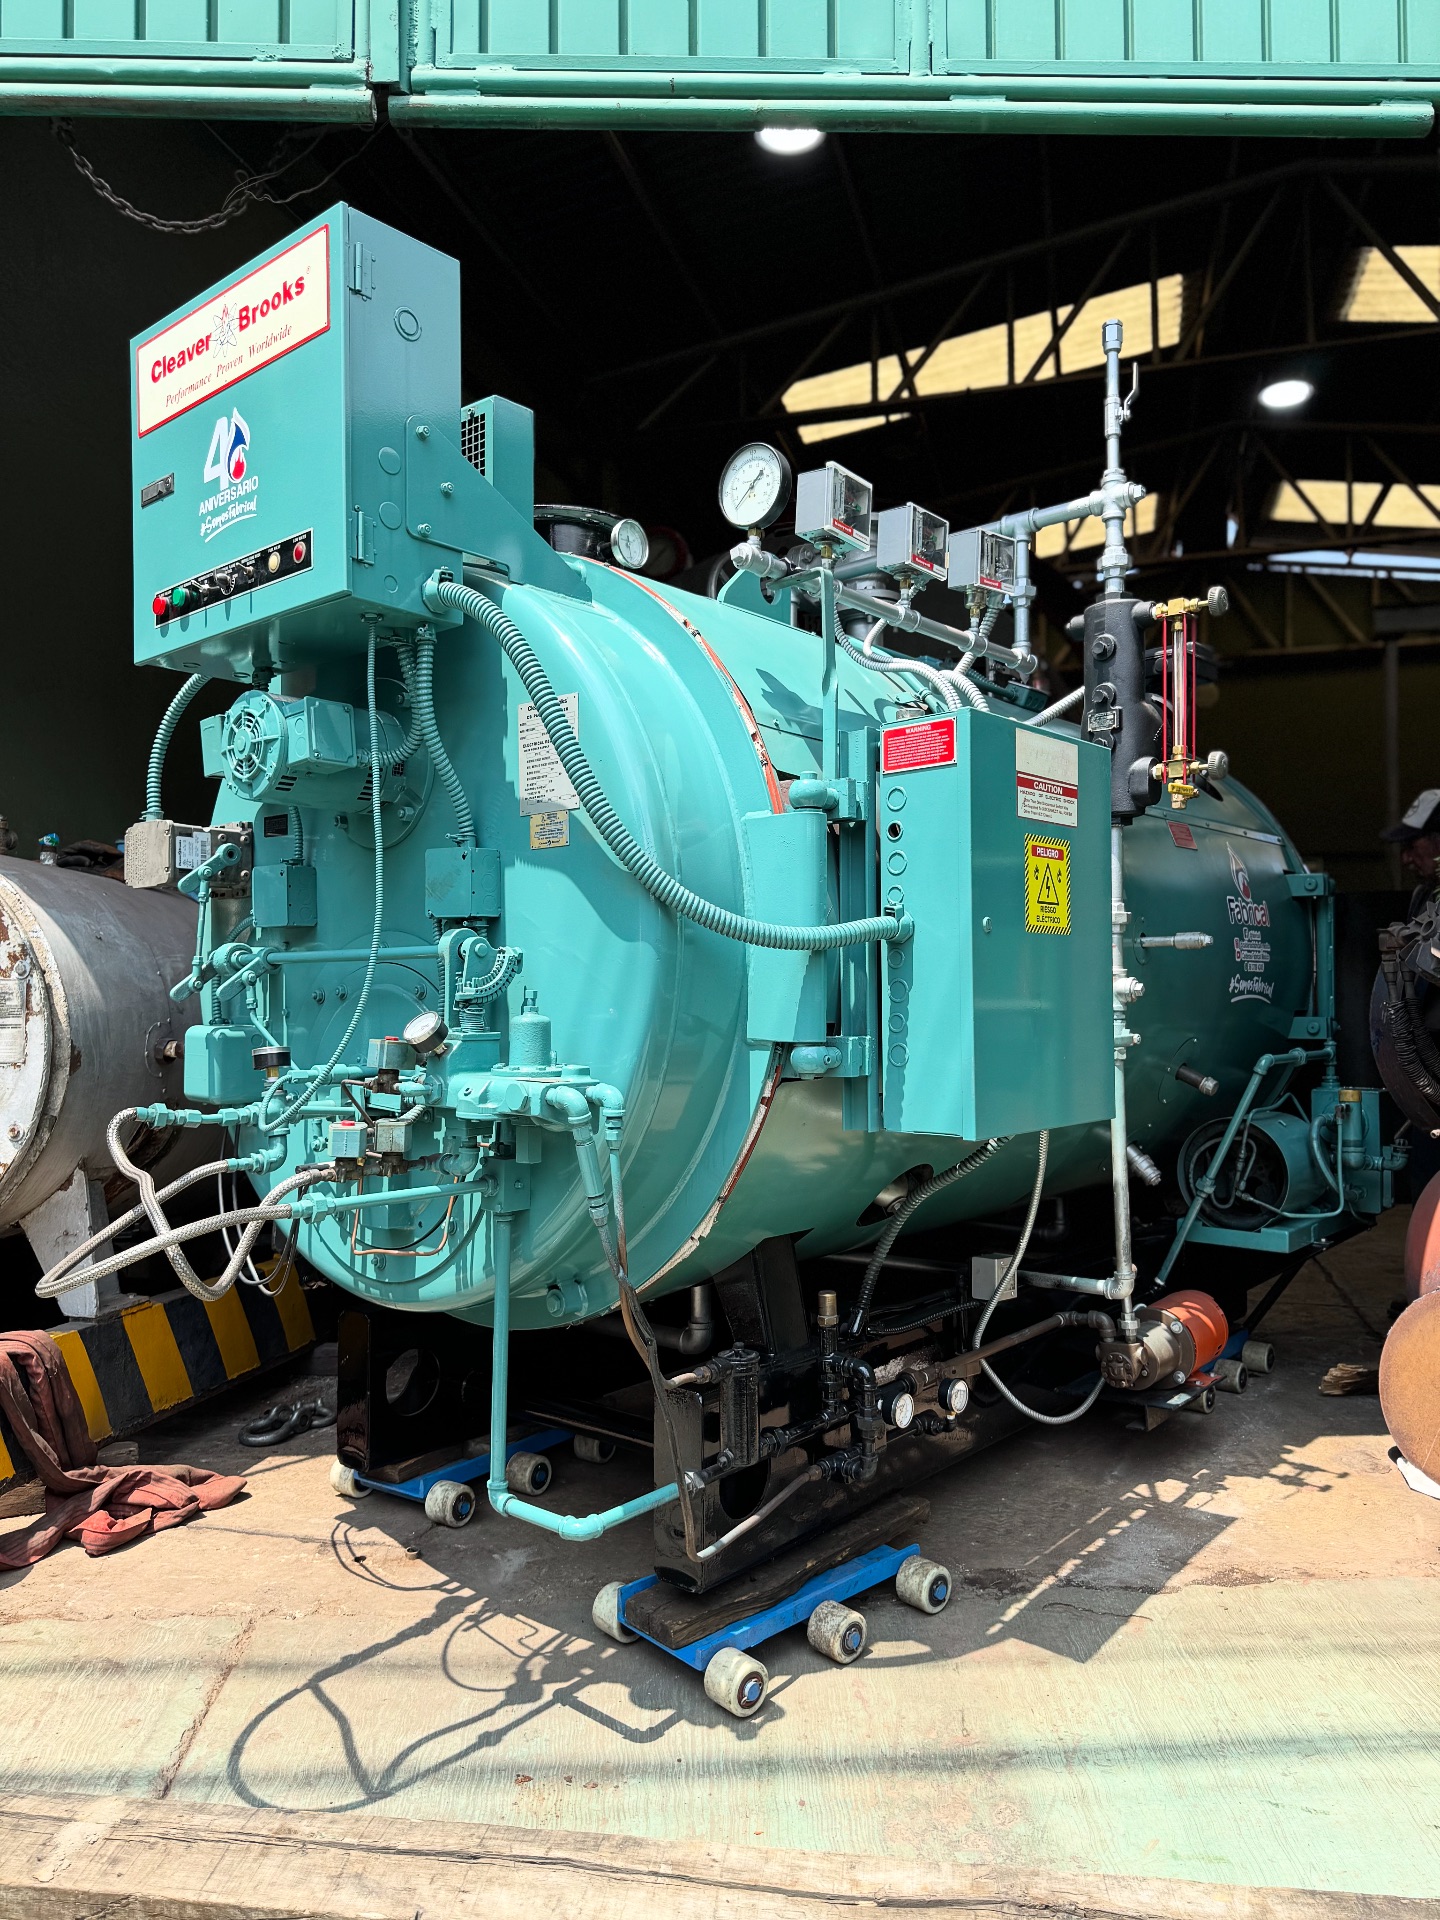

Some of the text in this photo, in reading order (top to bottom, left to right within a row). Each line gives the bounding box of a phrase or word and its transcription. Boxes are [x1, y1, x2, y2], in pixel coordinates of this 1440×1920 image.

[151, 276, 305, 383] Cleaver Brooks
[165, 324, 292, 407] Performance Proven Worldwide
[199, 476, 258, 516] ANIVERSARIO
[905, 724, 931, 734] WARNING
[1033, 781, 1063, 795] CAUTION
[1036, 847, 1059, 859] PELIGRO
[1039, 905, 1057, 914] RIESGO
[1226, 895, 1271, 927] Fabrical
[1036, 913, 1061, 924] ELÉCTRICO
